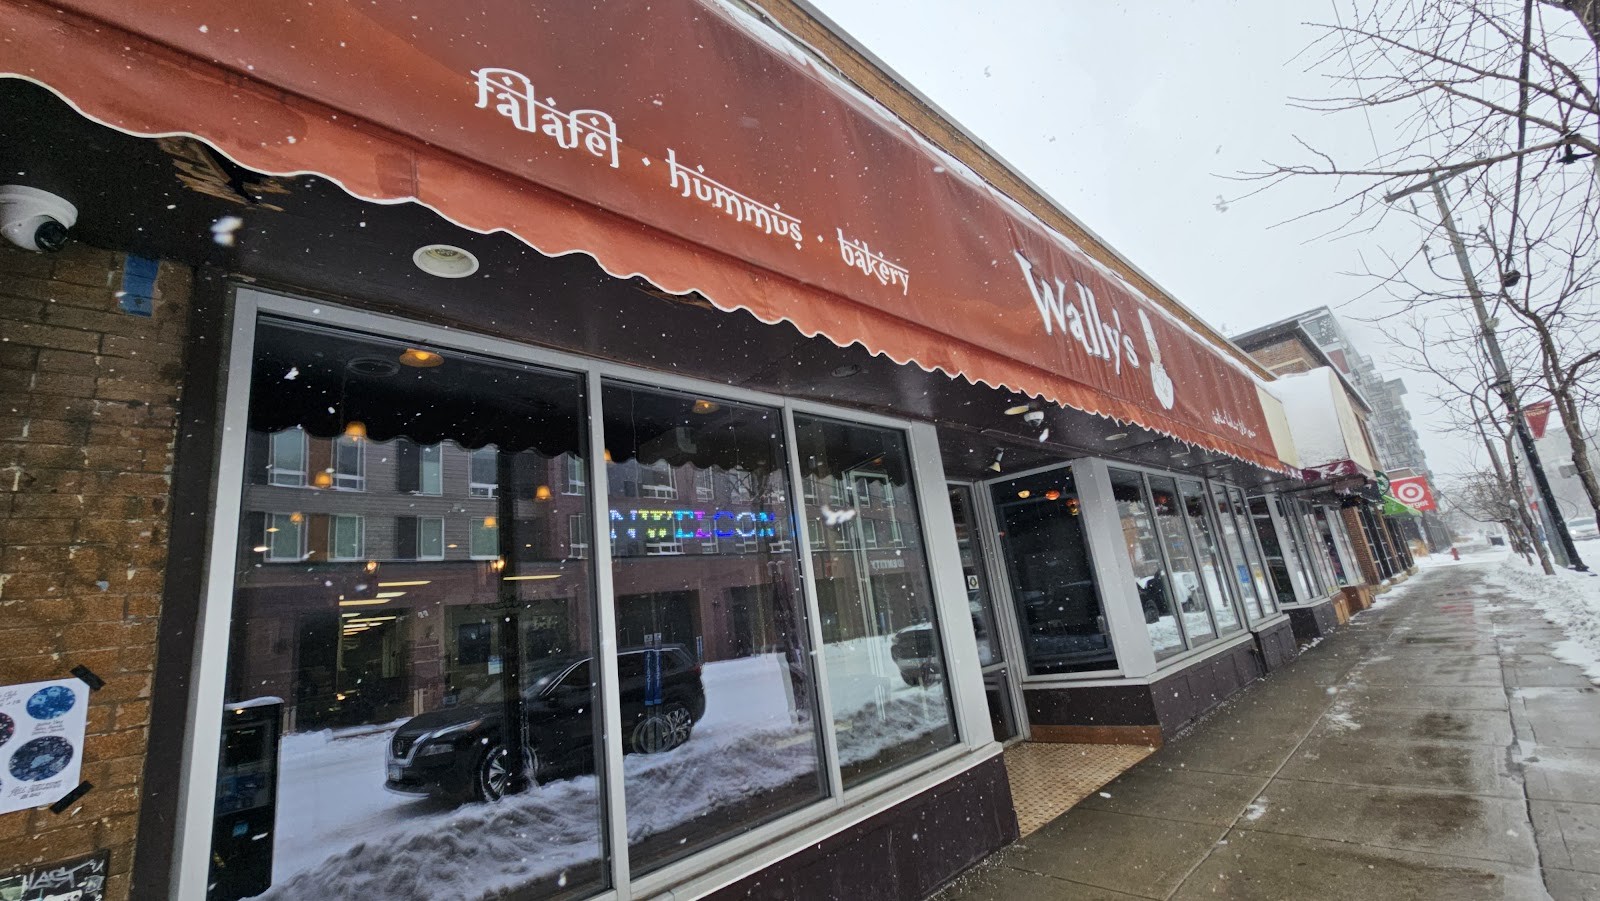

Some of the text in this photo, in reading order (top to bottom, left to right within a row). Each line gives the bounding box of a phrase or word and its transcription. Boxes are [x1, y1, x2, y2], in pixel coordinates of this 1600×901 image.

[470, 67, 910, 297] falafel hummus bakery
[1013, 250, 1140, 376] Wally's
